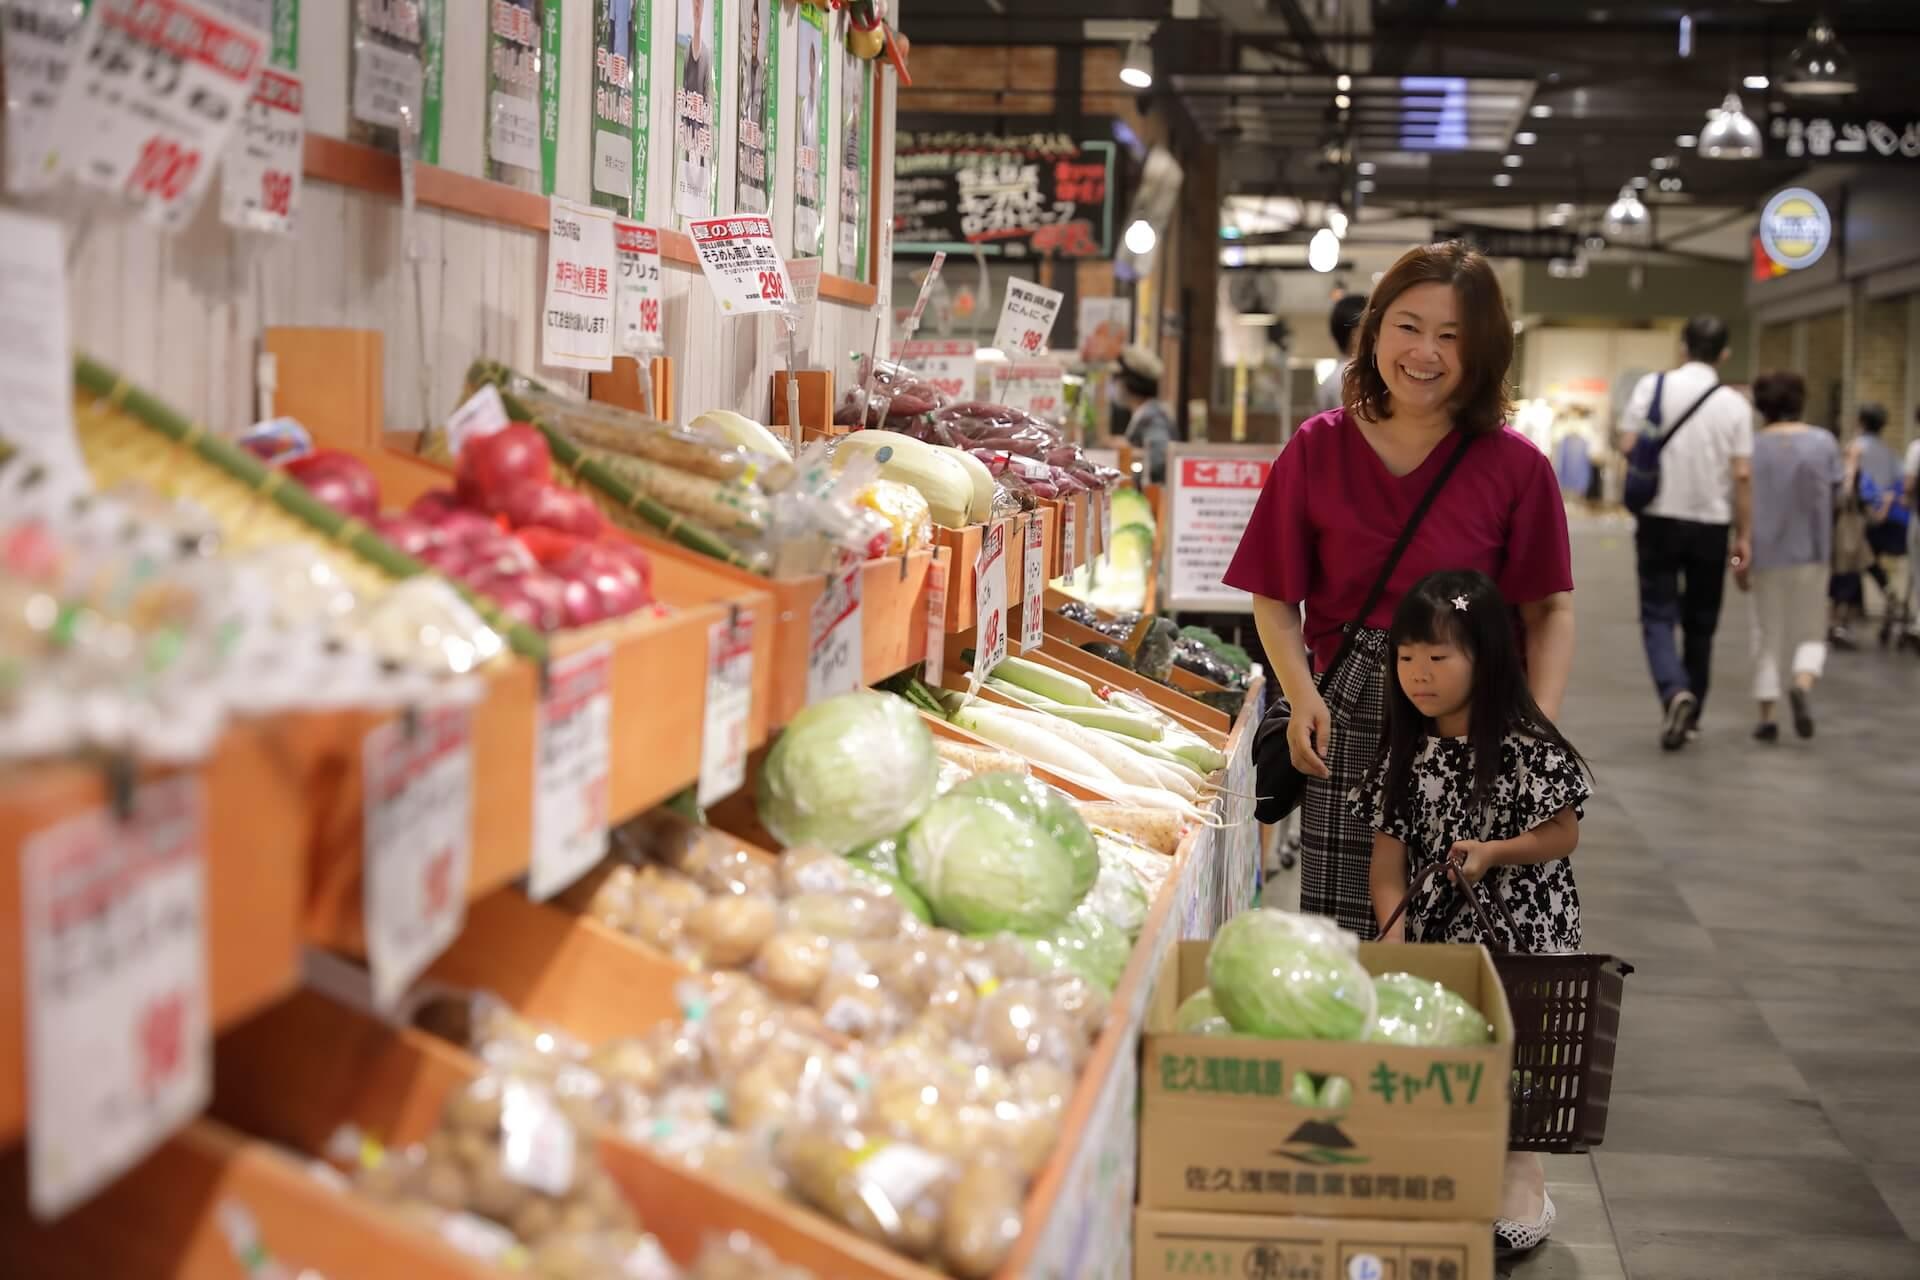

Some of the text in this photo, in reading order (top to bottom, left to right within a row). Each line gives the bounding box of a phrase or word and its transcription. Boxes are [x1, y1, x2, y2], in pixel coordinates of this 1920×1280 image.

[692, 220, 771, 240] 夏の御馳走
[758, 271, 785, 300] 298
[1007, 301, 1051, 324] にんにく
[1193, 461, 1262, 486] ご案内
[1369, 1059, 1485, 1105] キャベツ
[1185, 1166, 1456, 1201] 佐久浅間農業協同組合
